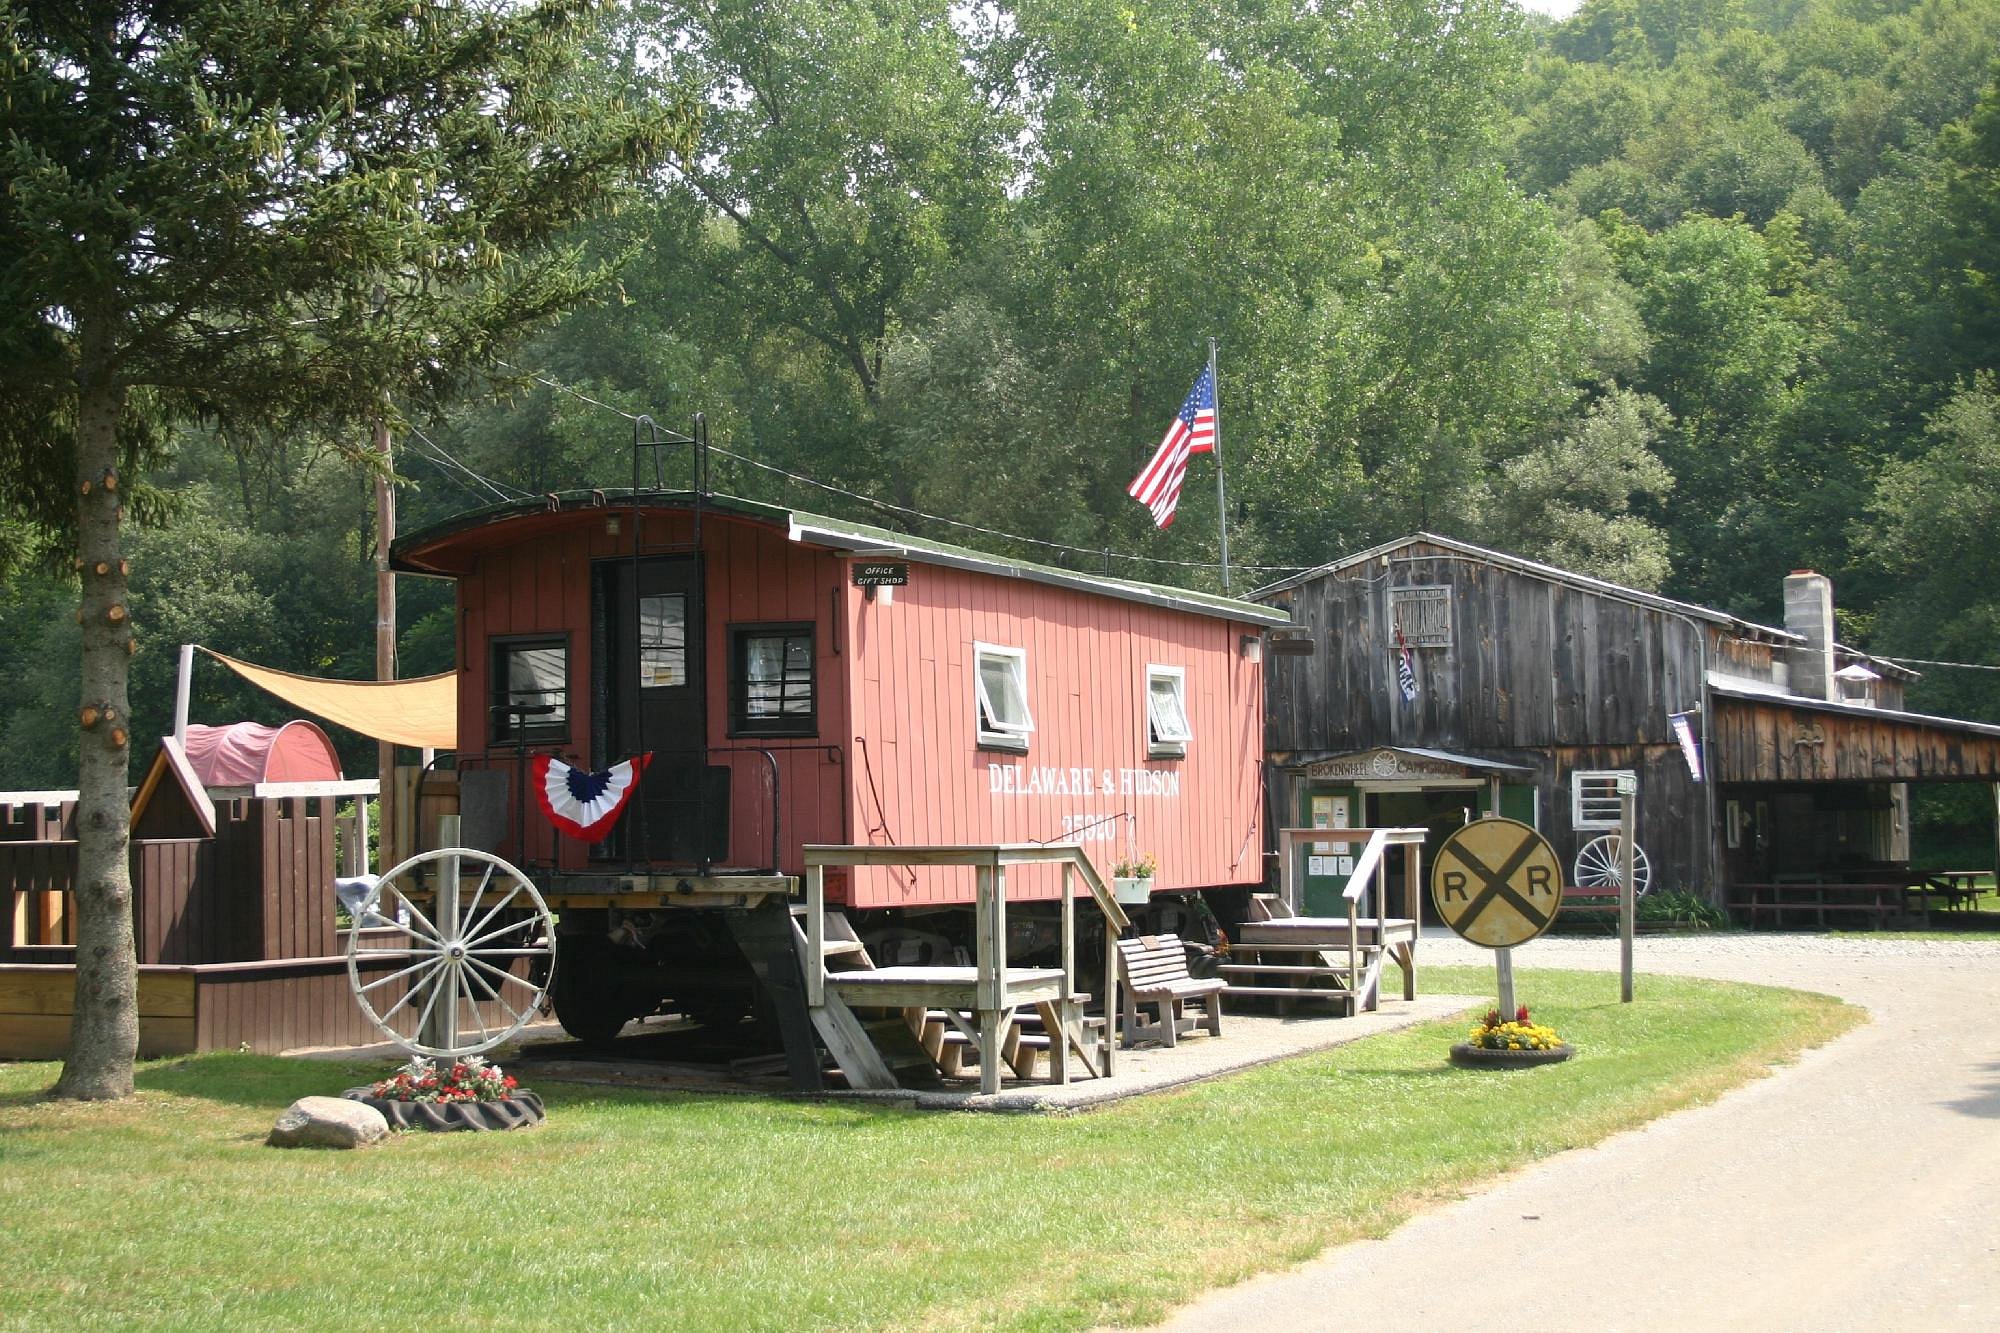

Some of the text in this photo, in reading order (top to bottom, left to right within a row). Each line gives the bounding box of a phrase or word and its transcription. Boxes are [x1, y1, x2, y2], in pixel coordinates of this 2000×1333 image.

[857, 577, 879, 585] GIFT
[865, 567, 894, 575] OFFICE
[988, 763, 1180, 796] DELAWARE & HUDSON
[1442, 864, 1553, 903] R R
